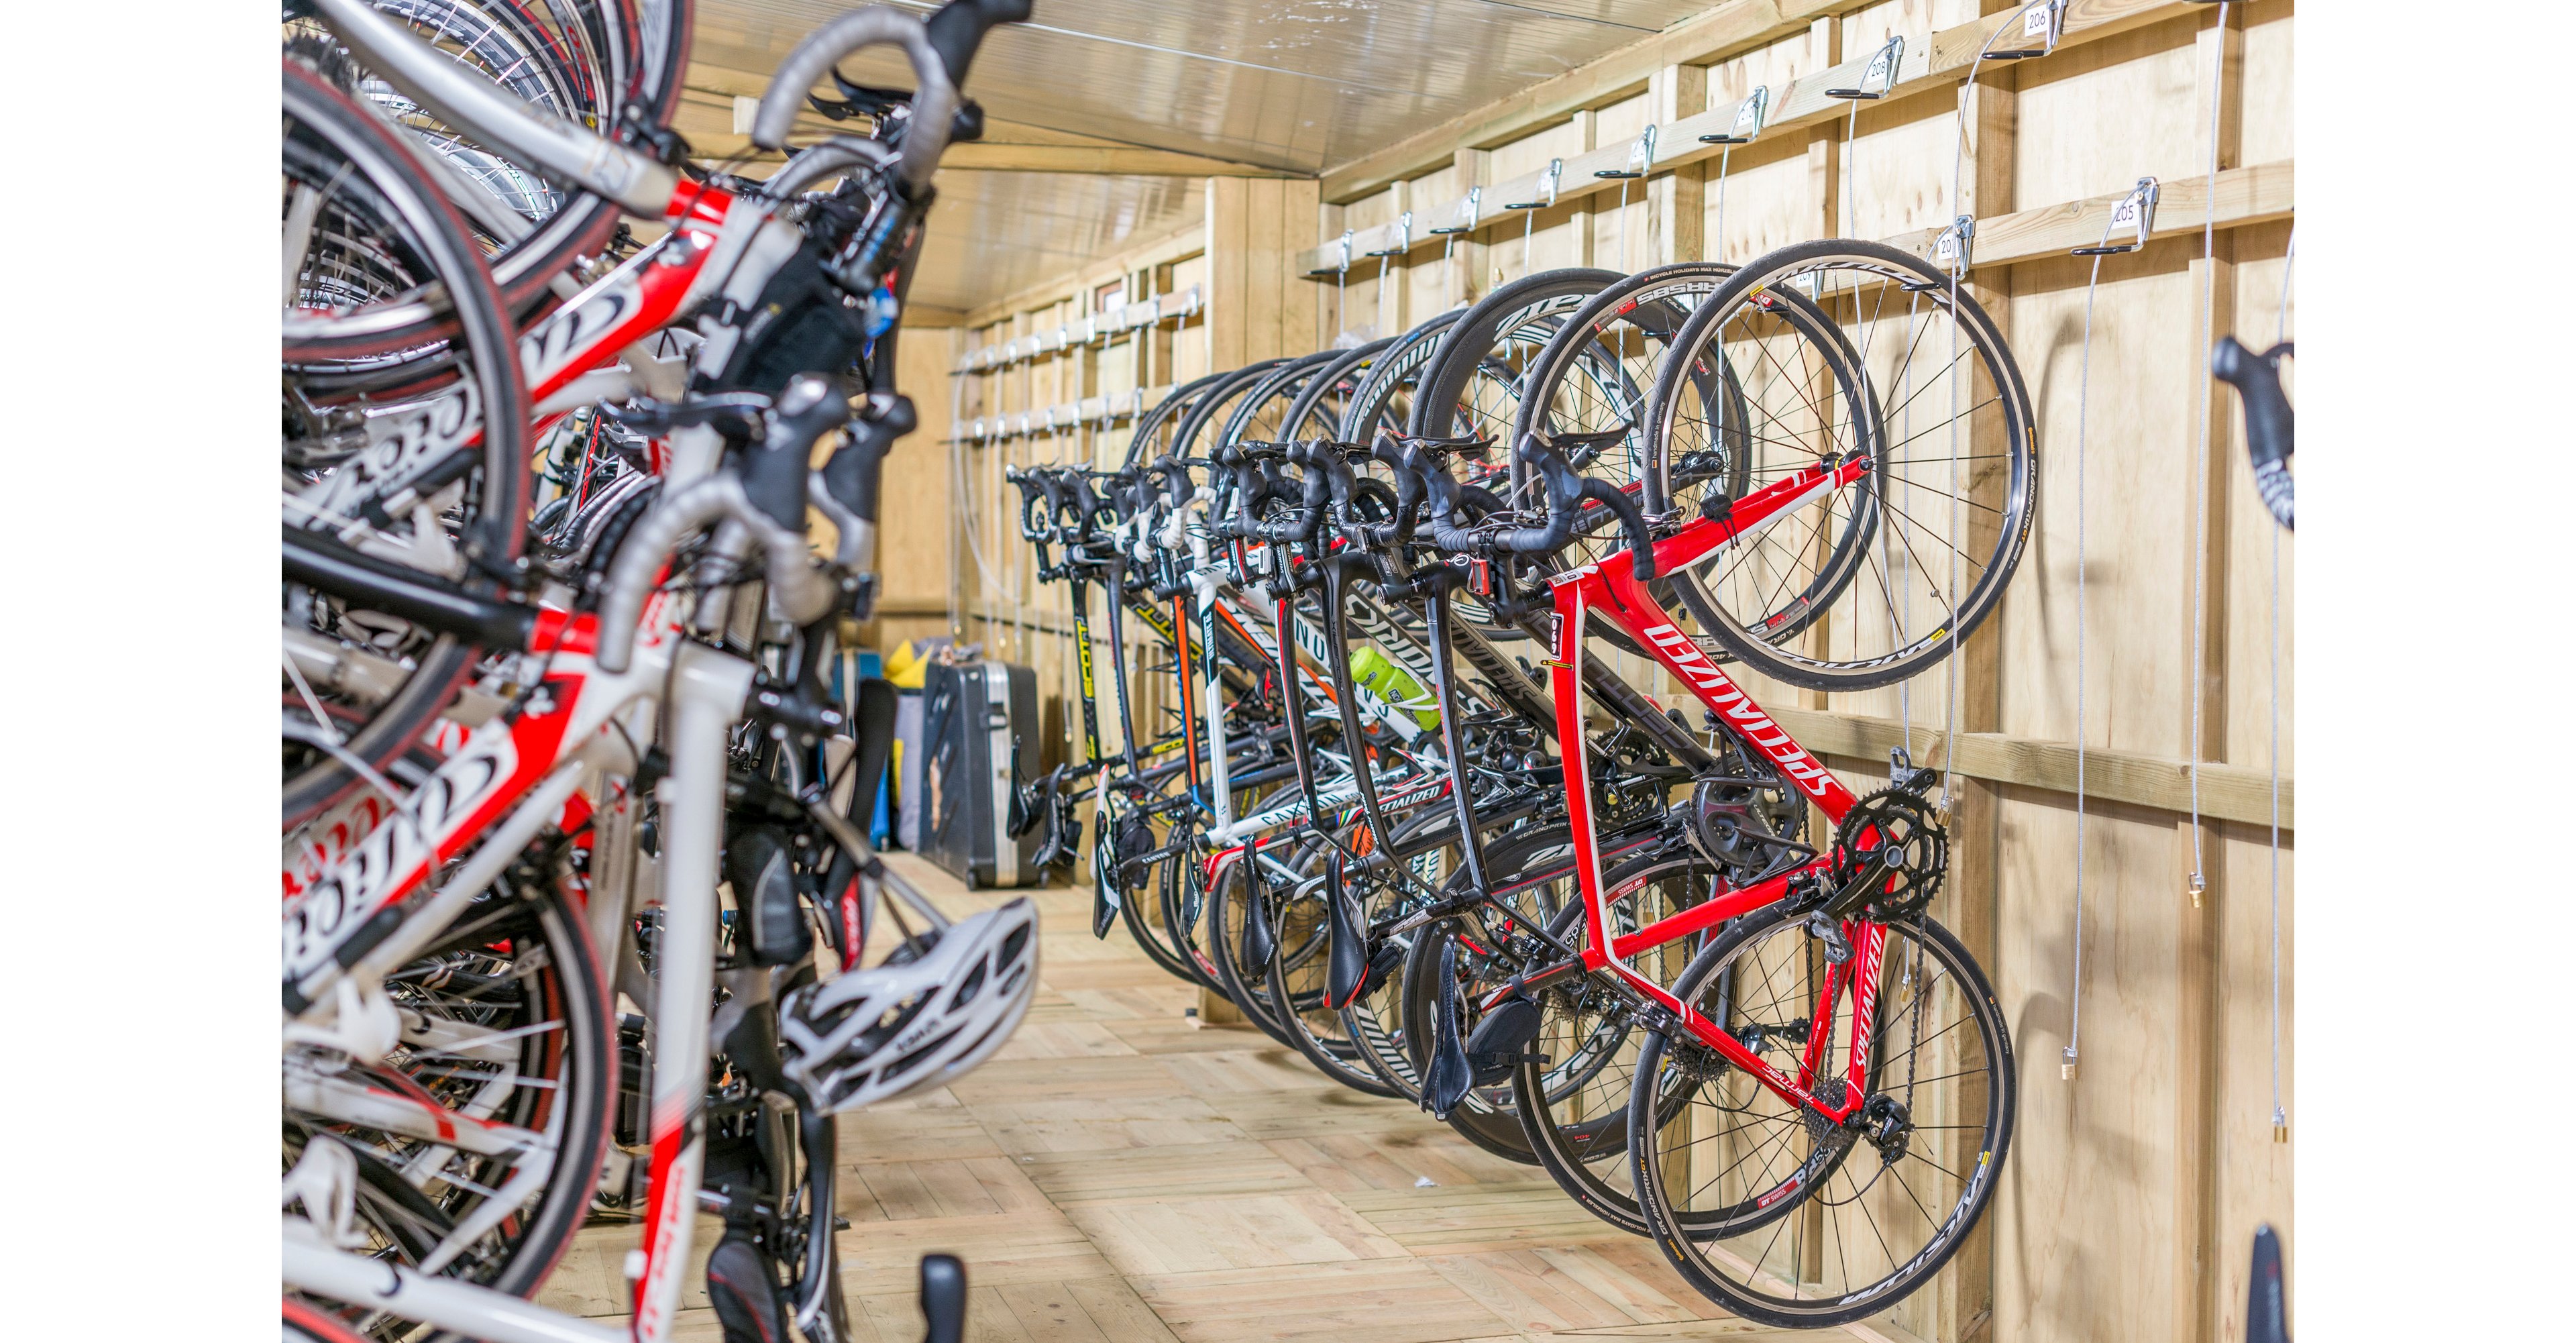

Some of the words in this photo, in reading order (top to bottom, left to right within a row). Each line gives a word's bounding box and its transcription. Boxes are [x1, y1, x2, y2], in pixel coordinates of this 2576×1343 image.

[2029, 10, 2046, 30] 206
[1871, 62, 1886, 77] 208
[2115, 204, 2134, 223] 205
[1650, 270, 1673, 280] BICYCLE
[1656, 401, 1666, 424] germany
[1076, 620, 1095, 698] SCOTT
[1644, 624, 1843, 796] SPECIALIZED
[1379, 785, 1440, 814] ECIALIZED
[1753, 804, 1776, 837] ULTEGR
[1141, 851, 1171, 864] CANYON
[1617, 883, 1634, 896] SWISS
[1634, 877, 1644, 887] DT
[1856, 928, 1883, 1069] SPECIALIZED
[1992, 1004, 2004, 1028] handmade
[2002, 1033, 2010, 1055] germany
[1761, 1197, 1770, 1207] DT
[1770, 1189, 1787, 1202] SWISS
